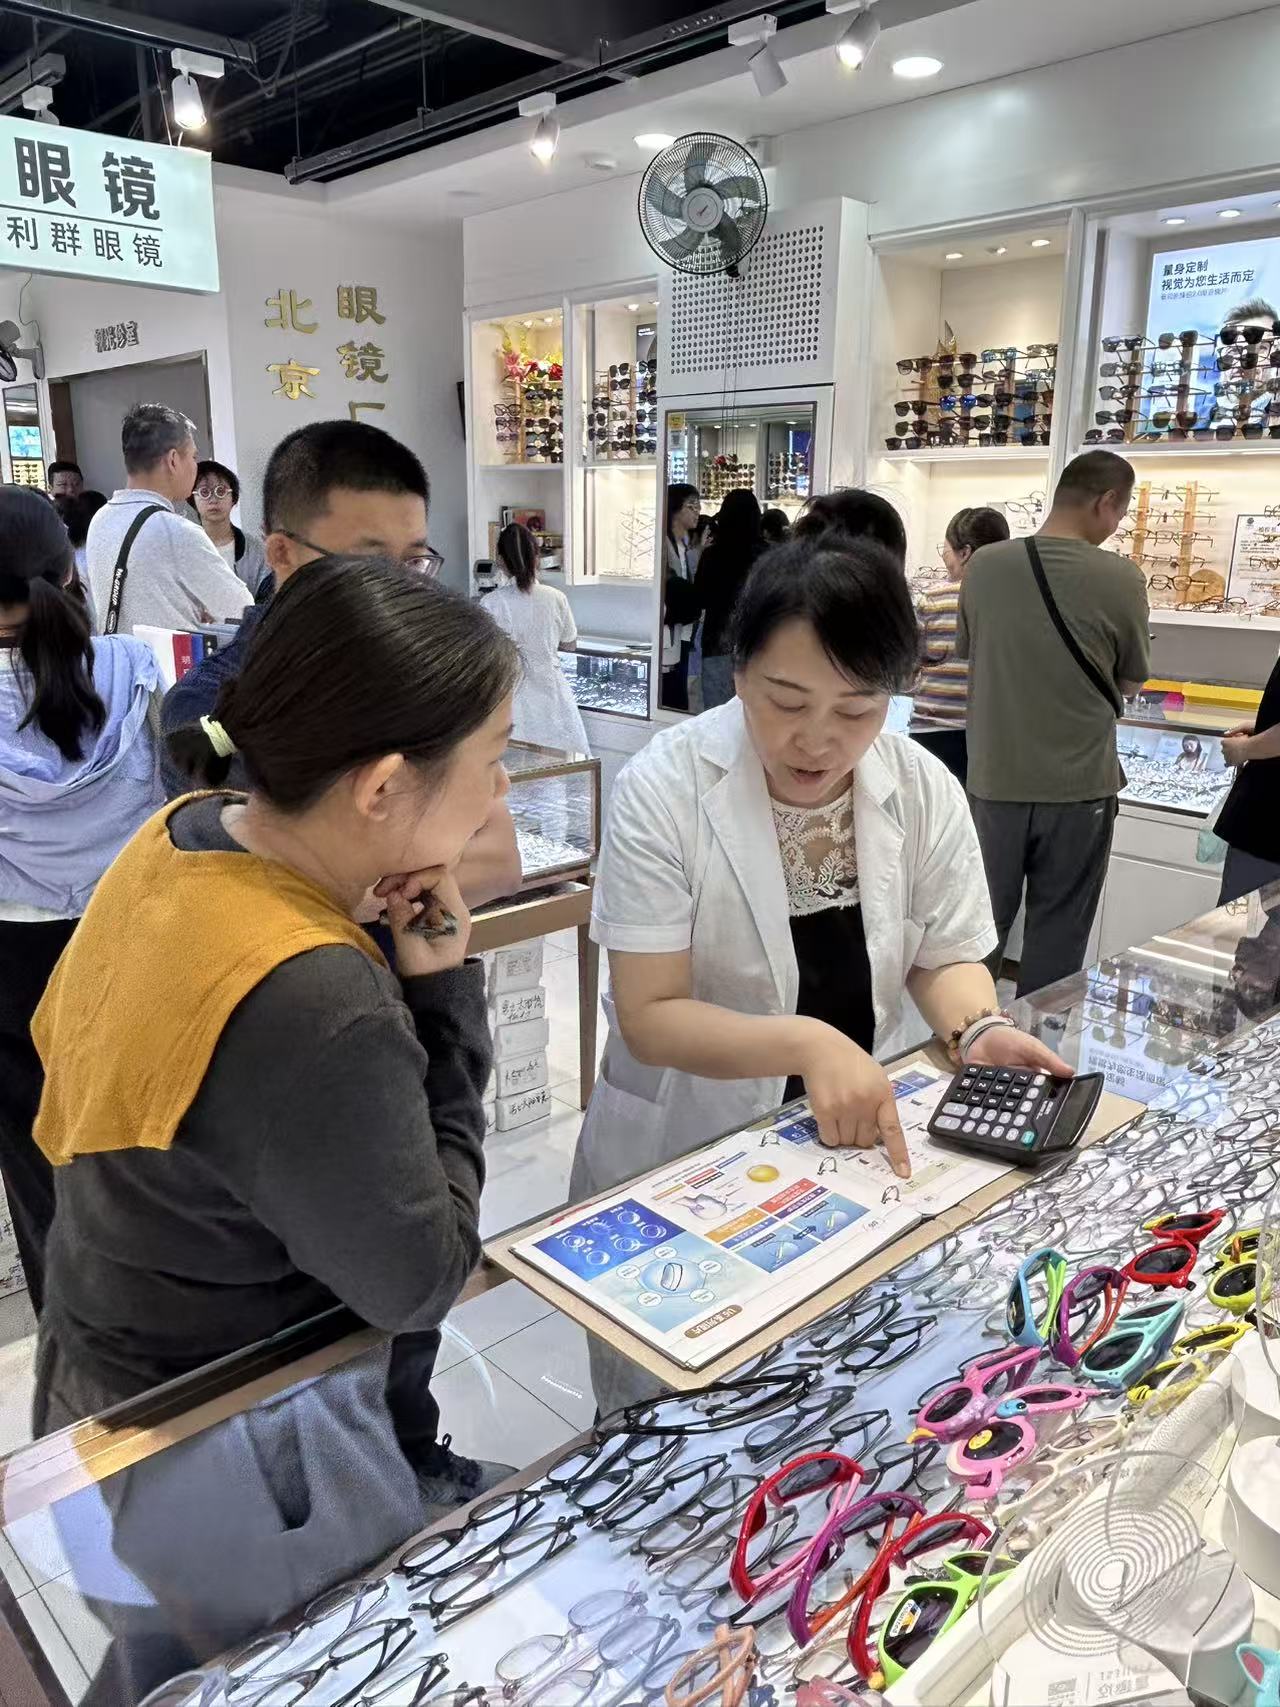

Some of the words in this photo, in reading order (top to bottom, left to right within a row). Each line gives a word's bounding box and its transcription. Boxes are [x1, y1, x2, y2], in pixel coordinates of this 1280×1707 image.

[15, 136, 160, 220] 眼镜
[7, 215, 163, 267] 利群眼镜
[1161, 269, 1255, 291] 视觉为您生活而定
[1162, 258, 1209, 277] 量身定制
